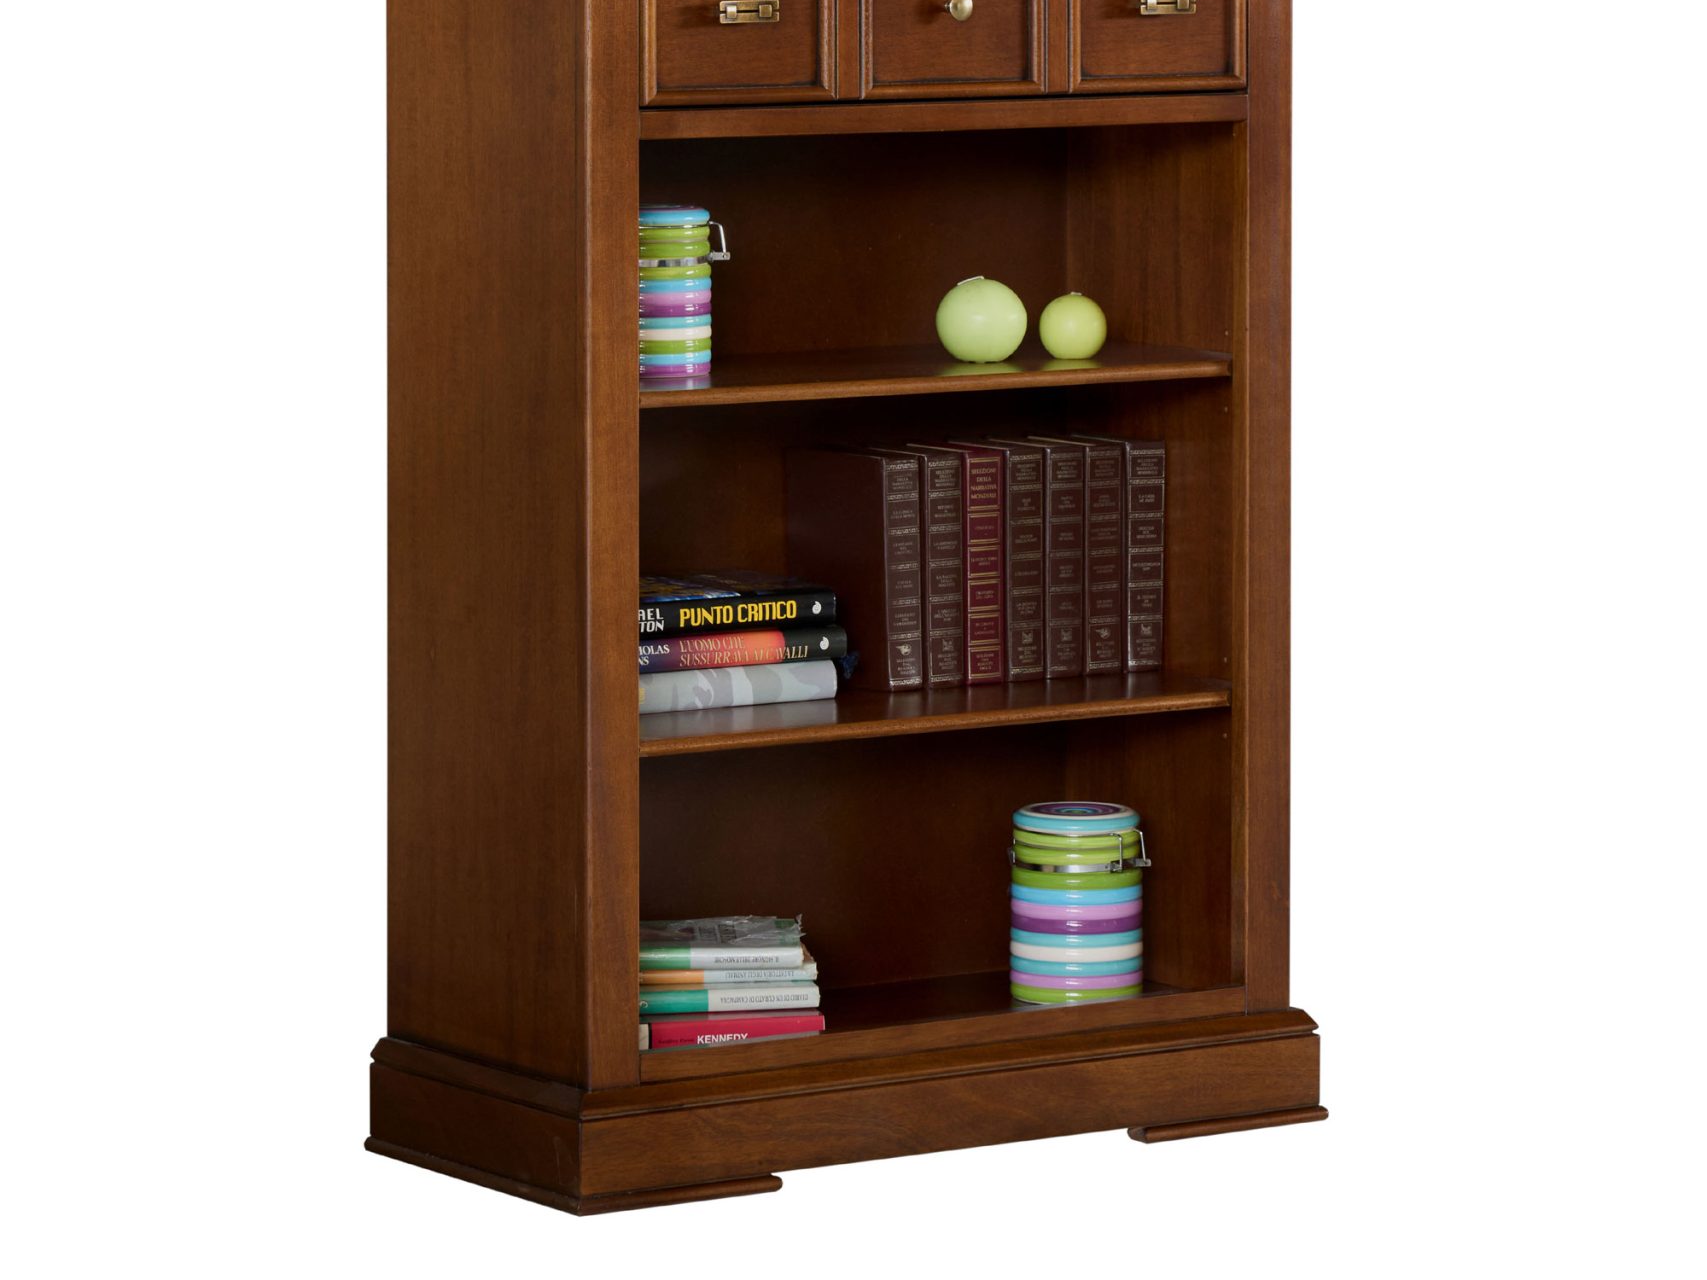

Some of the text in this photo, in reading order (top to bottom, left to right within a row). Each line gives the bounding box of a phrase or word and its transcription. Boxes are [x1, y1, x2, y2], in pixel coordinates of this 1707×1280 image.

[679, 599, 798, 628] PUNTO CRITICO
[722, 635, 745, 650] CHE
[697, 1032, 748, 1045] KENNEDY
